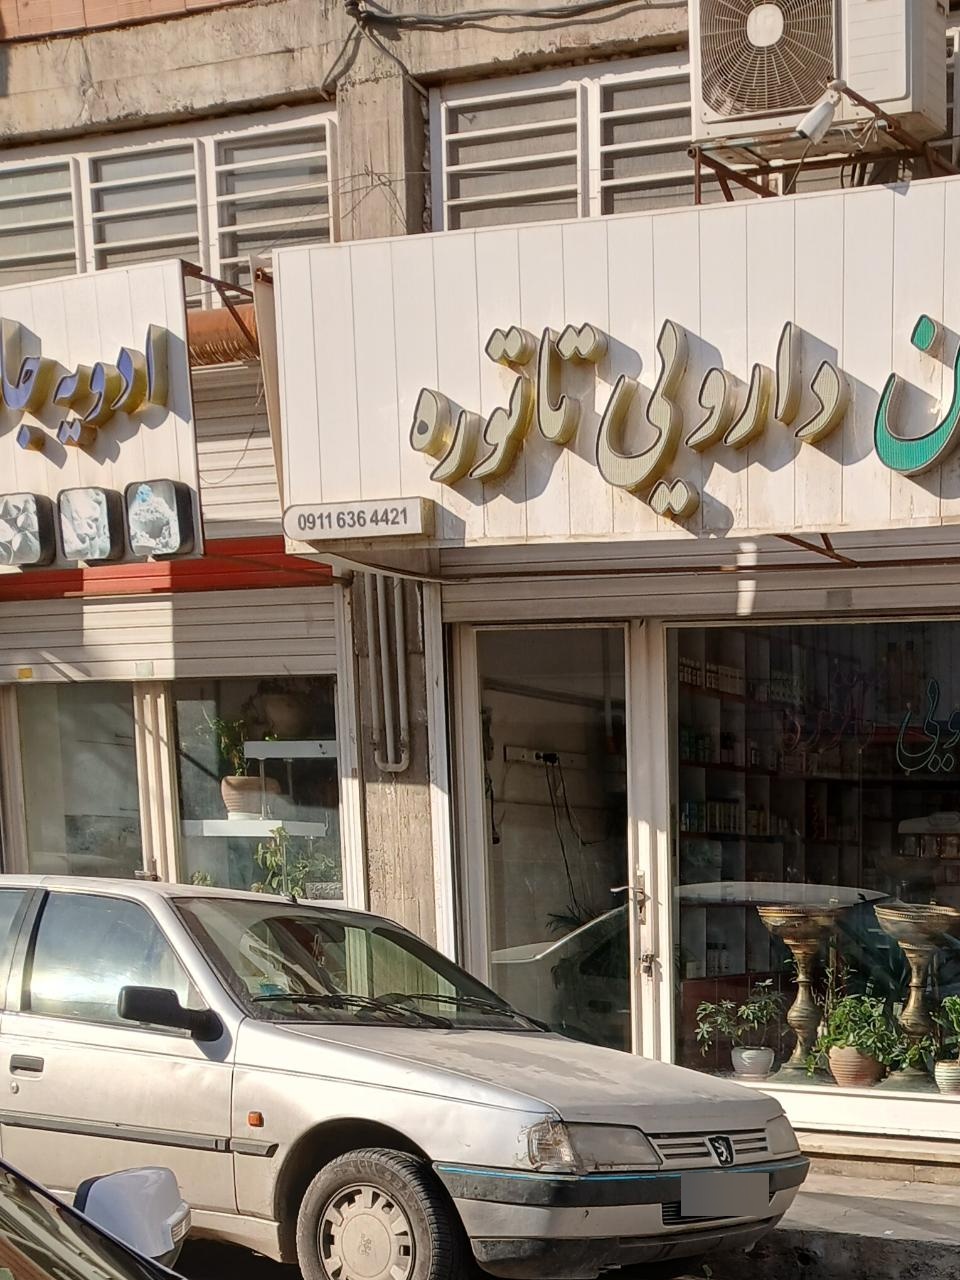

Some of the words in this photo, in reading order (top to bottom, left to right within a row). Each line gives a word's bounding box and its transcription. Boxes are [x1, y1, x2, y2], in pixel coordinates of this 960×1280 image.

[408, 322, 607, 484] تاتوره
[297, 513, 332, 531] 0911
[336, 510, 367, 528] 636
[370, 507, 408, 526] 4421
